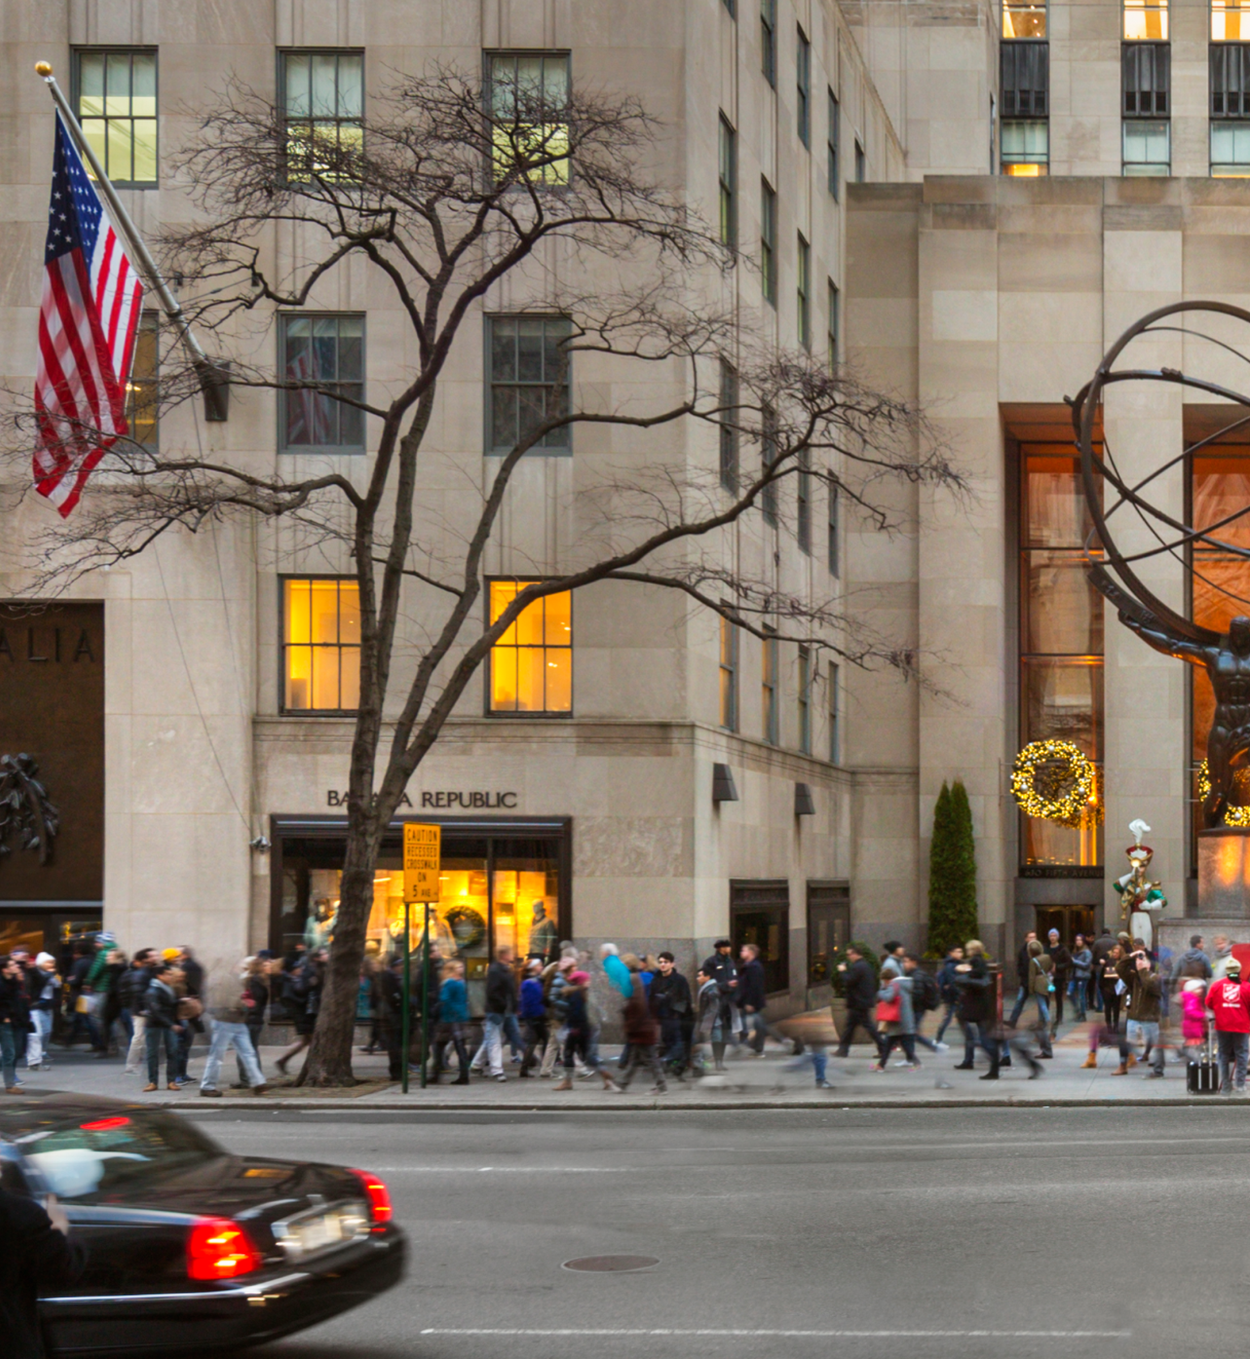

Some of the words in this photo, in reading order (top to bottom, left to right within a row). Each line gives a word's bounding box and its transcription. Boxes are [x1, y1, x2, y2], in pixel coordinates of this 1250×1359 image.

[327, 790, 412, 807] BAAA
[422, 791, 517, 809] REPUBLIC
[407, 829, 438, 842] CAUTION
[407, 846, 438, 857] RECESSED
[406, 858, 438, 870] CROSSWALK
[418, 872, 427, 882] ON
[1046, 869, 1068, 877] FIFTH
[413, 884, 418, 897] 5
